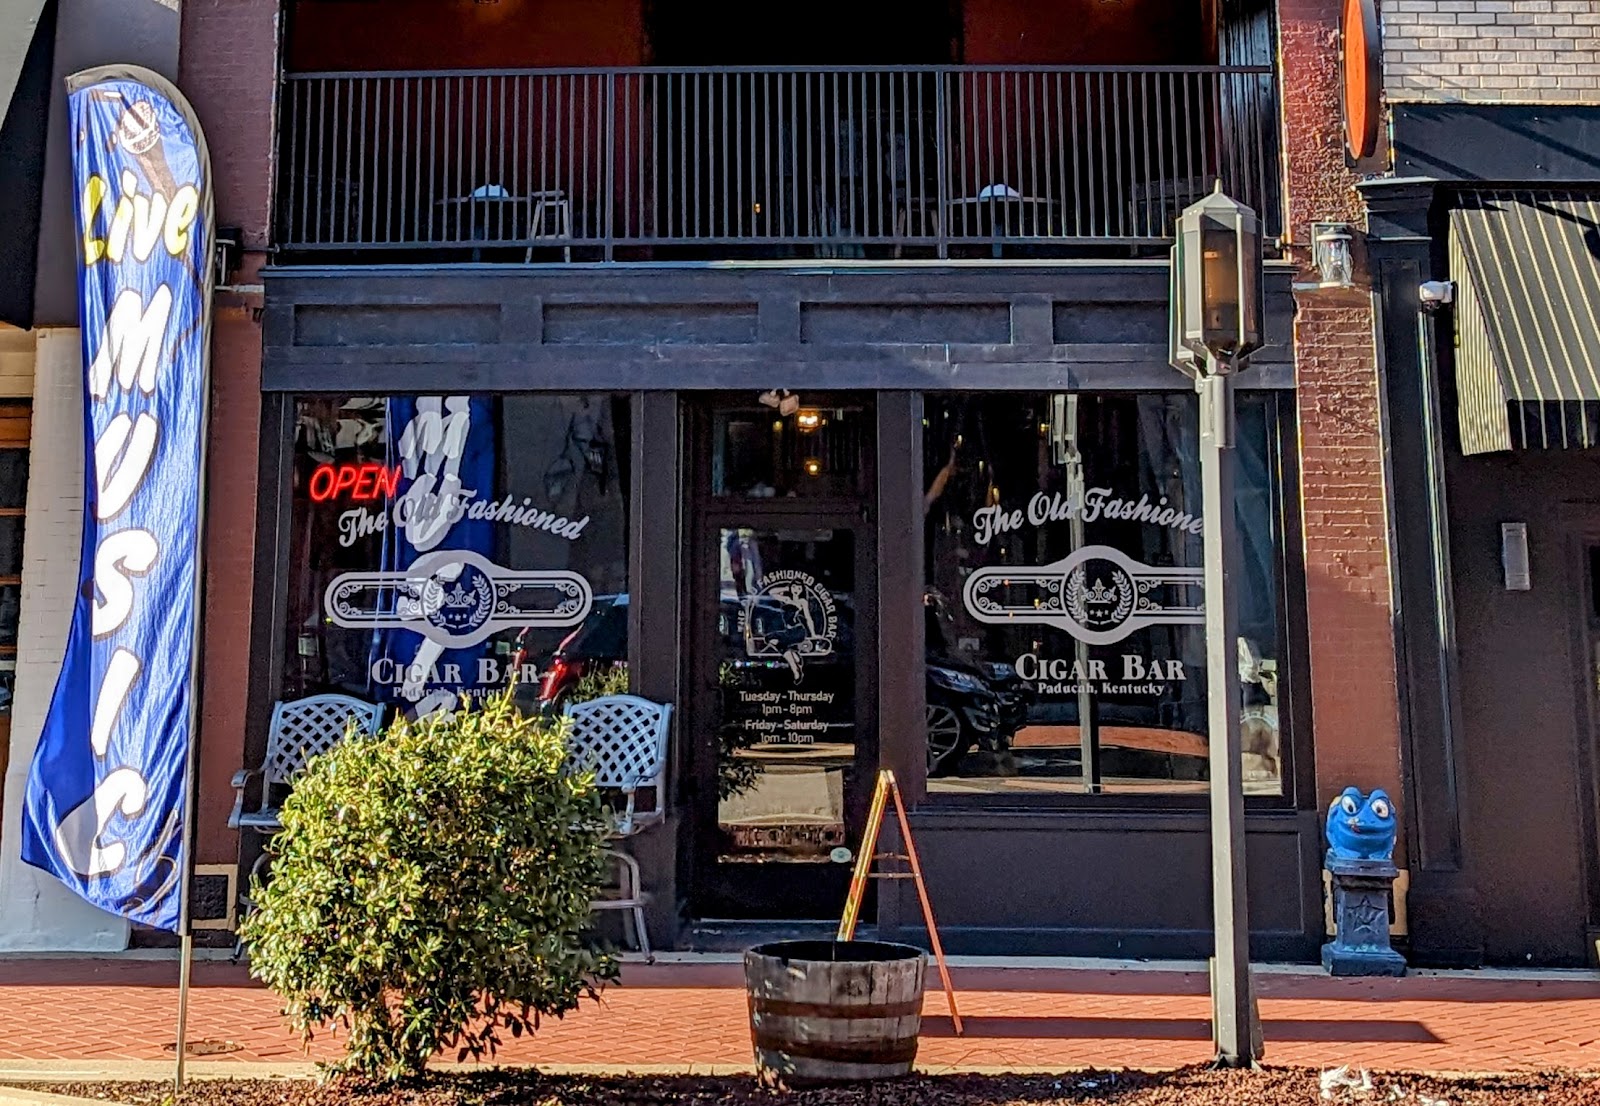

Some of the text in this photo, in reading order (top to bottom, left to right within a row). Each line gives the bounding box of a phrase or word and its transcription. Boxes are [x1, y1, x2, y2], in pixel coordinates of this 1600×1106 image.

[307, 464, 402, 502] OPEN
[338, 488, 590, 548] The Old Fashioned
[973, 487, 1204, 545] The Old Fashione
[56, 282, 174, 878] MUSIC
[756, 569, 816, 590] FASHIONED
[812, 582, 837, 615] CIGAR
[825, 615, 838, 641] BAR
[739, 690, 781, 704] Tuesday
[787, 690, 834, 704] Thursday
[1037, 682, 1165, 696] Paducah, Kentucky
[762, 703, 782, 716] 1pm
[789, 703, 813, 716] 8pm
[745, 719, 777, 733] Friday
[783, 719, 829, 733] Saturday
[760, 732, 780, 743] 1pm
[787, 732, 814, 744] 10pm
